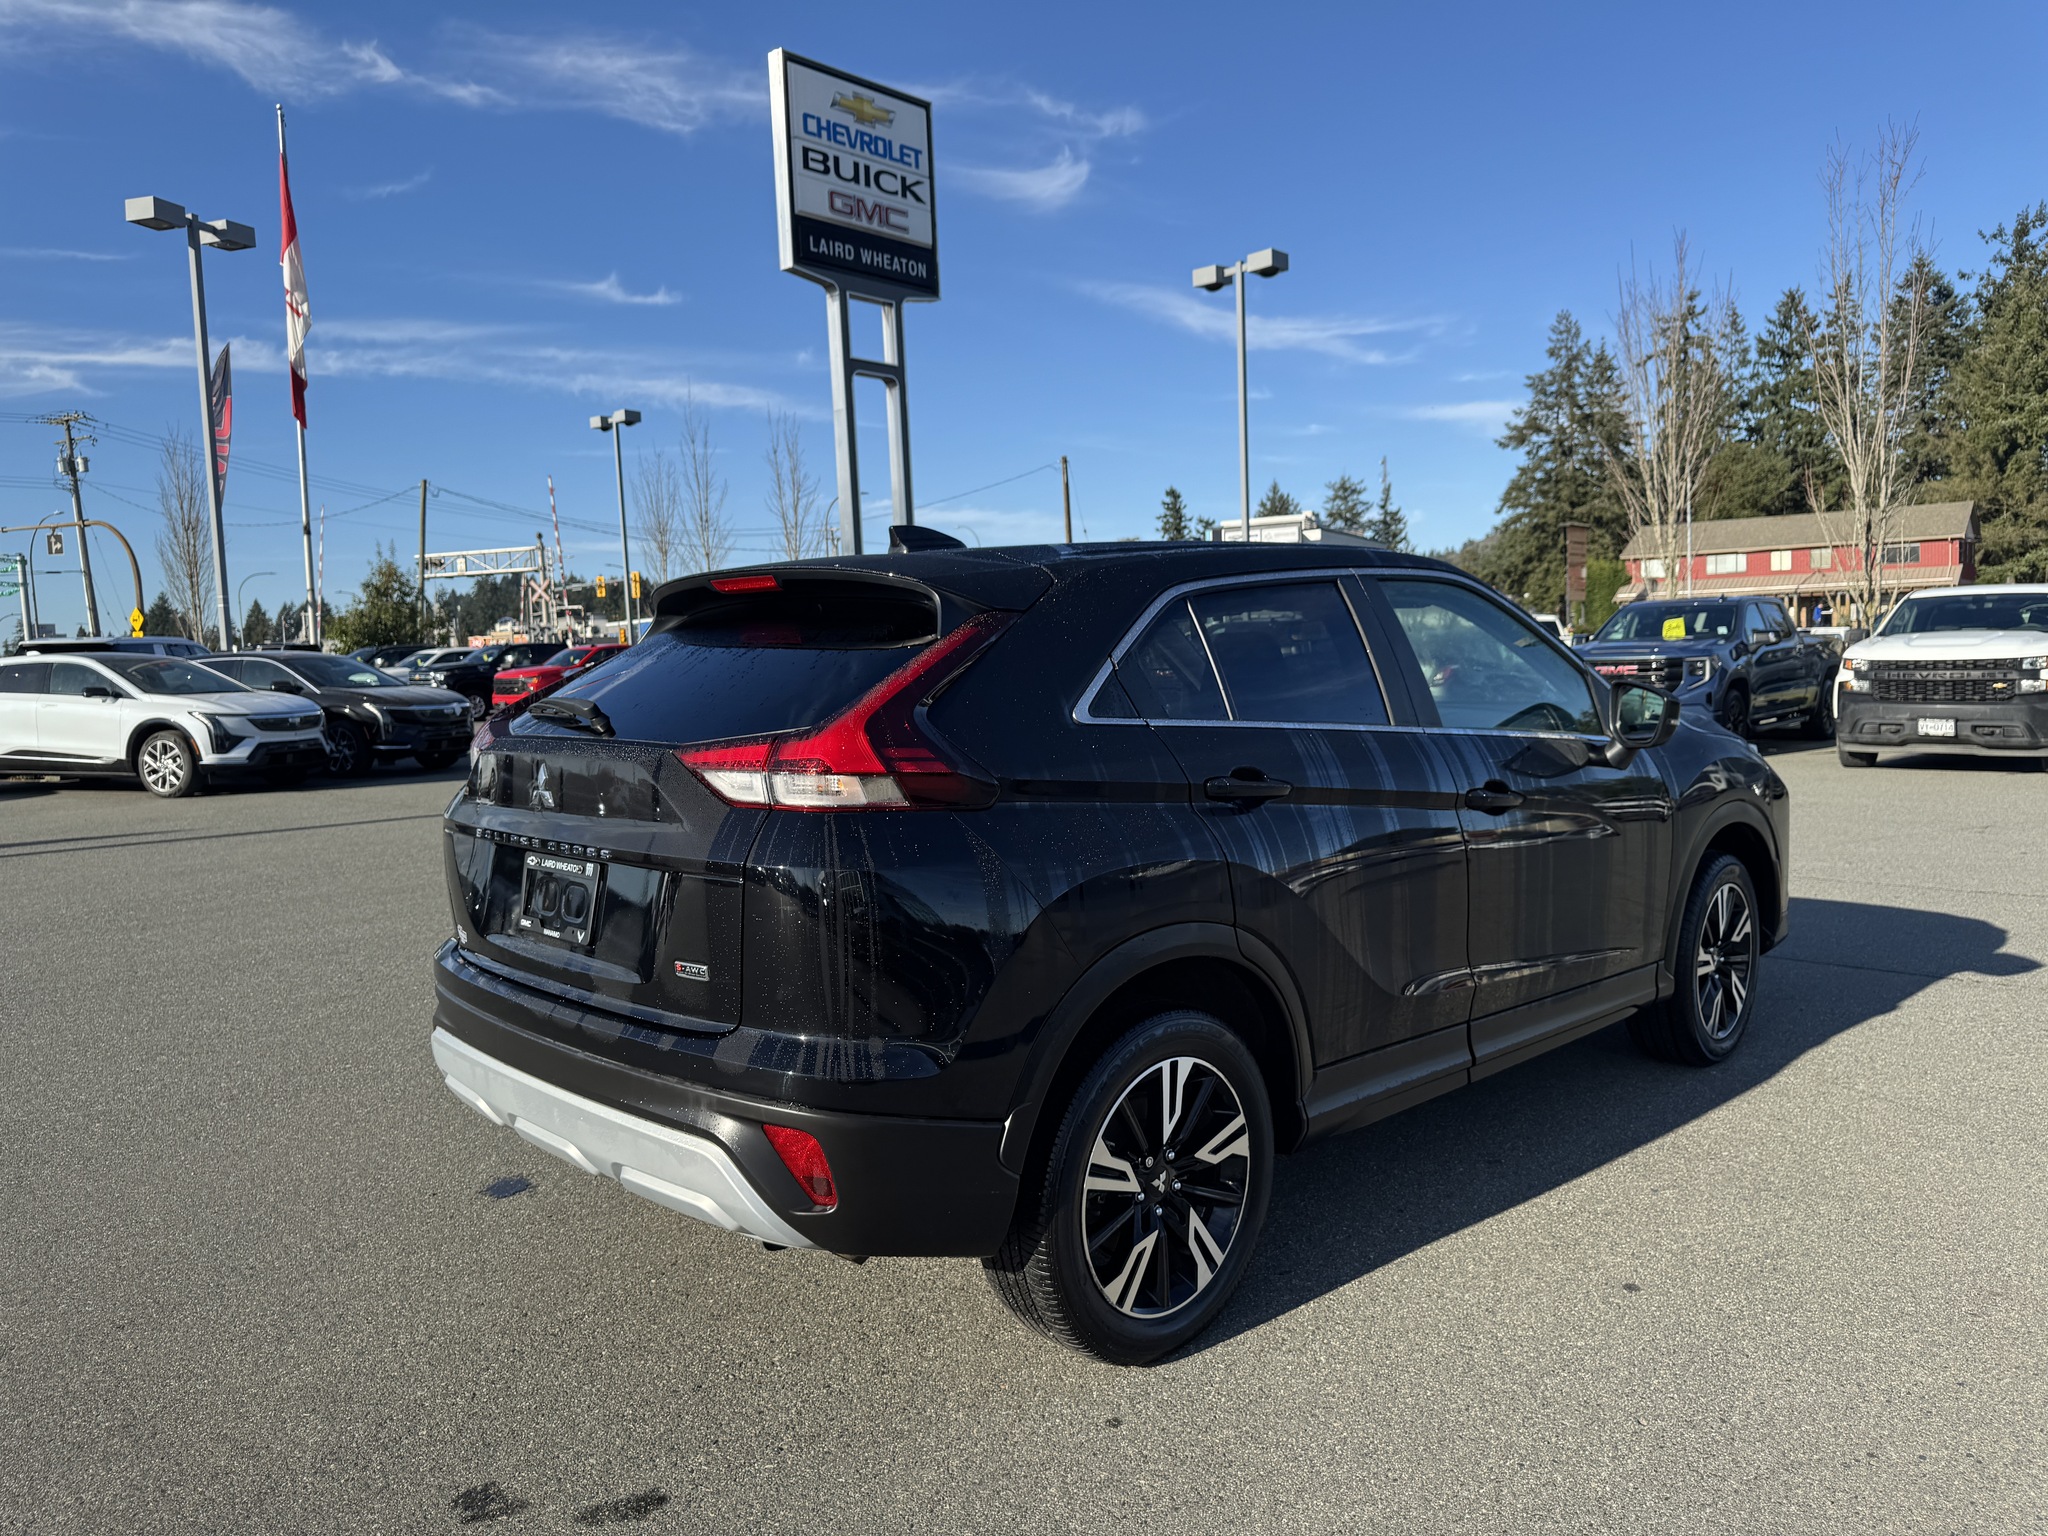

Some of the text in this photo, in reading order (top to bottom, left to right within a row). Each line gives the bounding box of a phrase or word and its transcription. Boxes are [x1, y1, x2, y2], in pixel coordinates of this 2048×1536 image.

[802, 112, 923, 170] CHEVROLET
[802, 146, 926, 205] BUICK
[828, 190, 910, 235] GMC
[809, 235, 928, 279] LAIRD WHEATON
[1873, 670, 2014, 681] CHEVROLET
[475, 828, 613, 860] ECLIPSE CROSS
